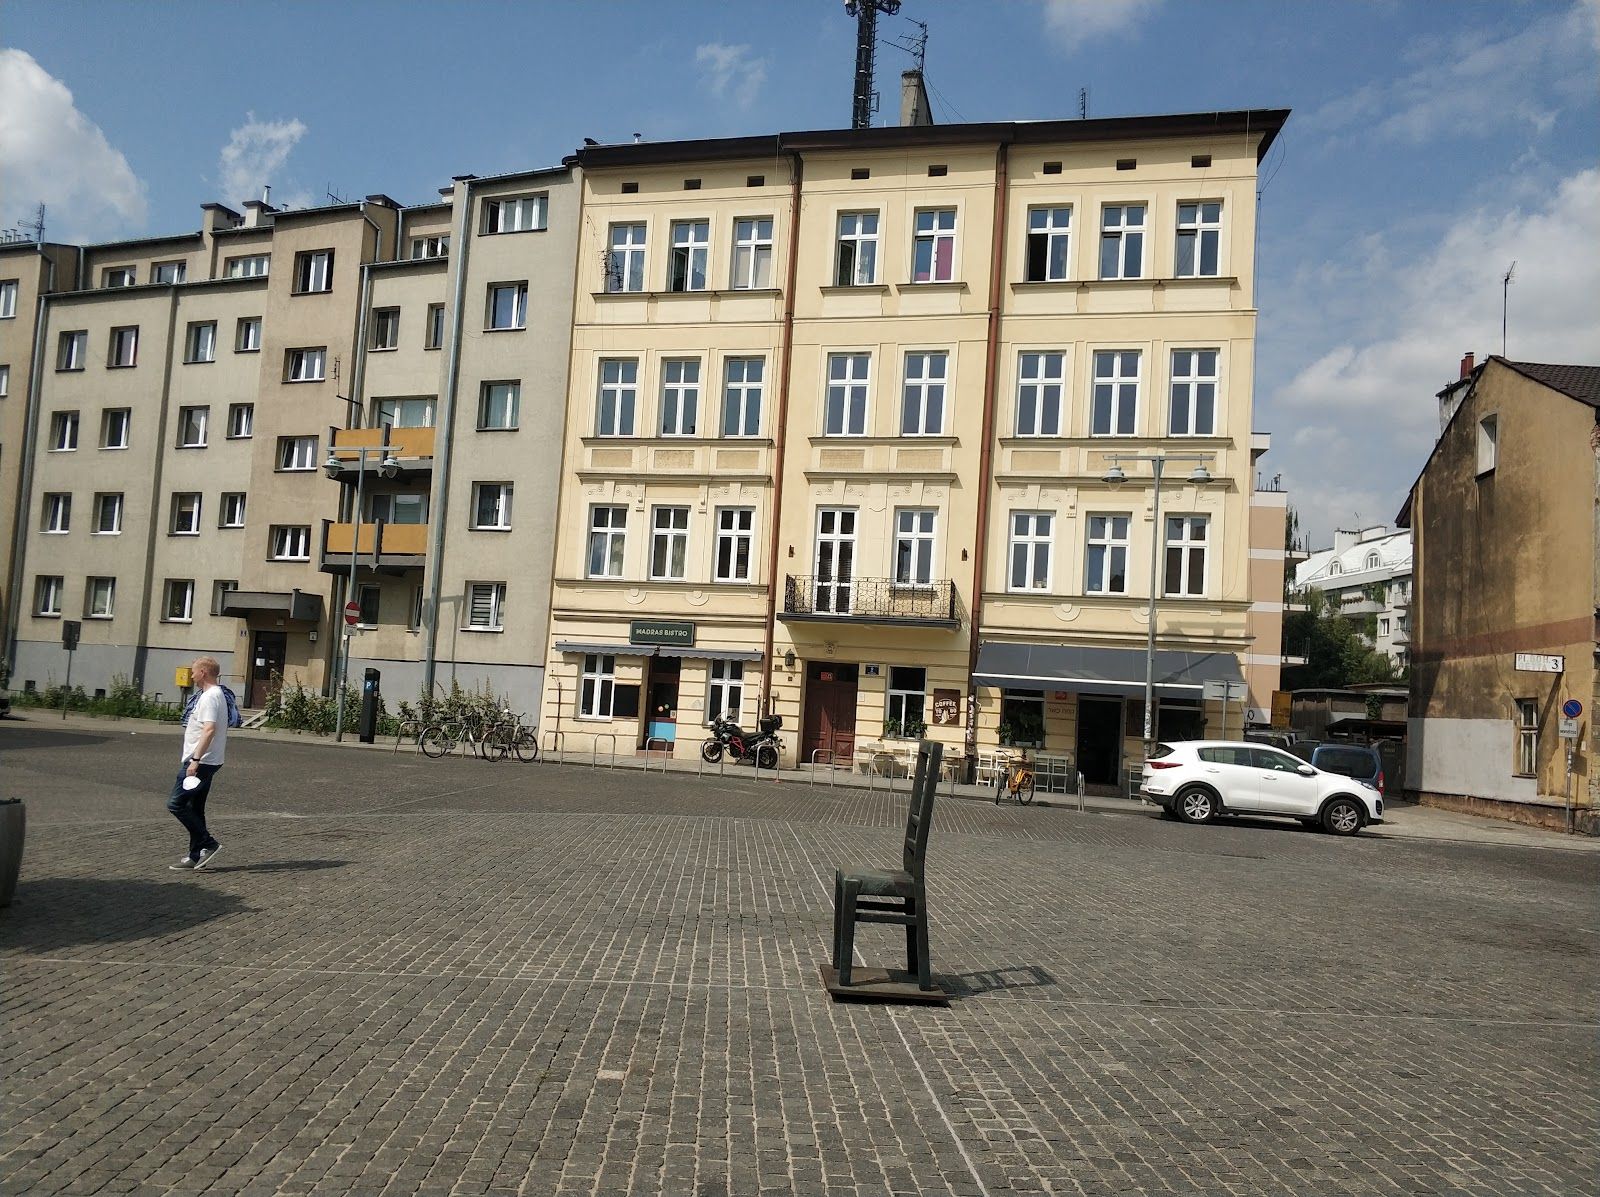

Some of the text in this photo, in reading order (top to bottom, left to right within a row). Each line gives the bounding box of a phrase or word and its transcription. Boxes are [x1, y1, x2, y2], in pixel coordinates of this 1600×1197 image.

[635, 628, 688, 637] MADRAS BISTRO
[1551, 658, 1559, 670] 3
[366, 681, 372, 689] P
[934, 700, 957, 708] COFFEE
